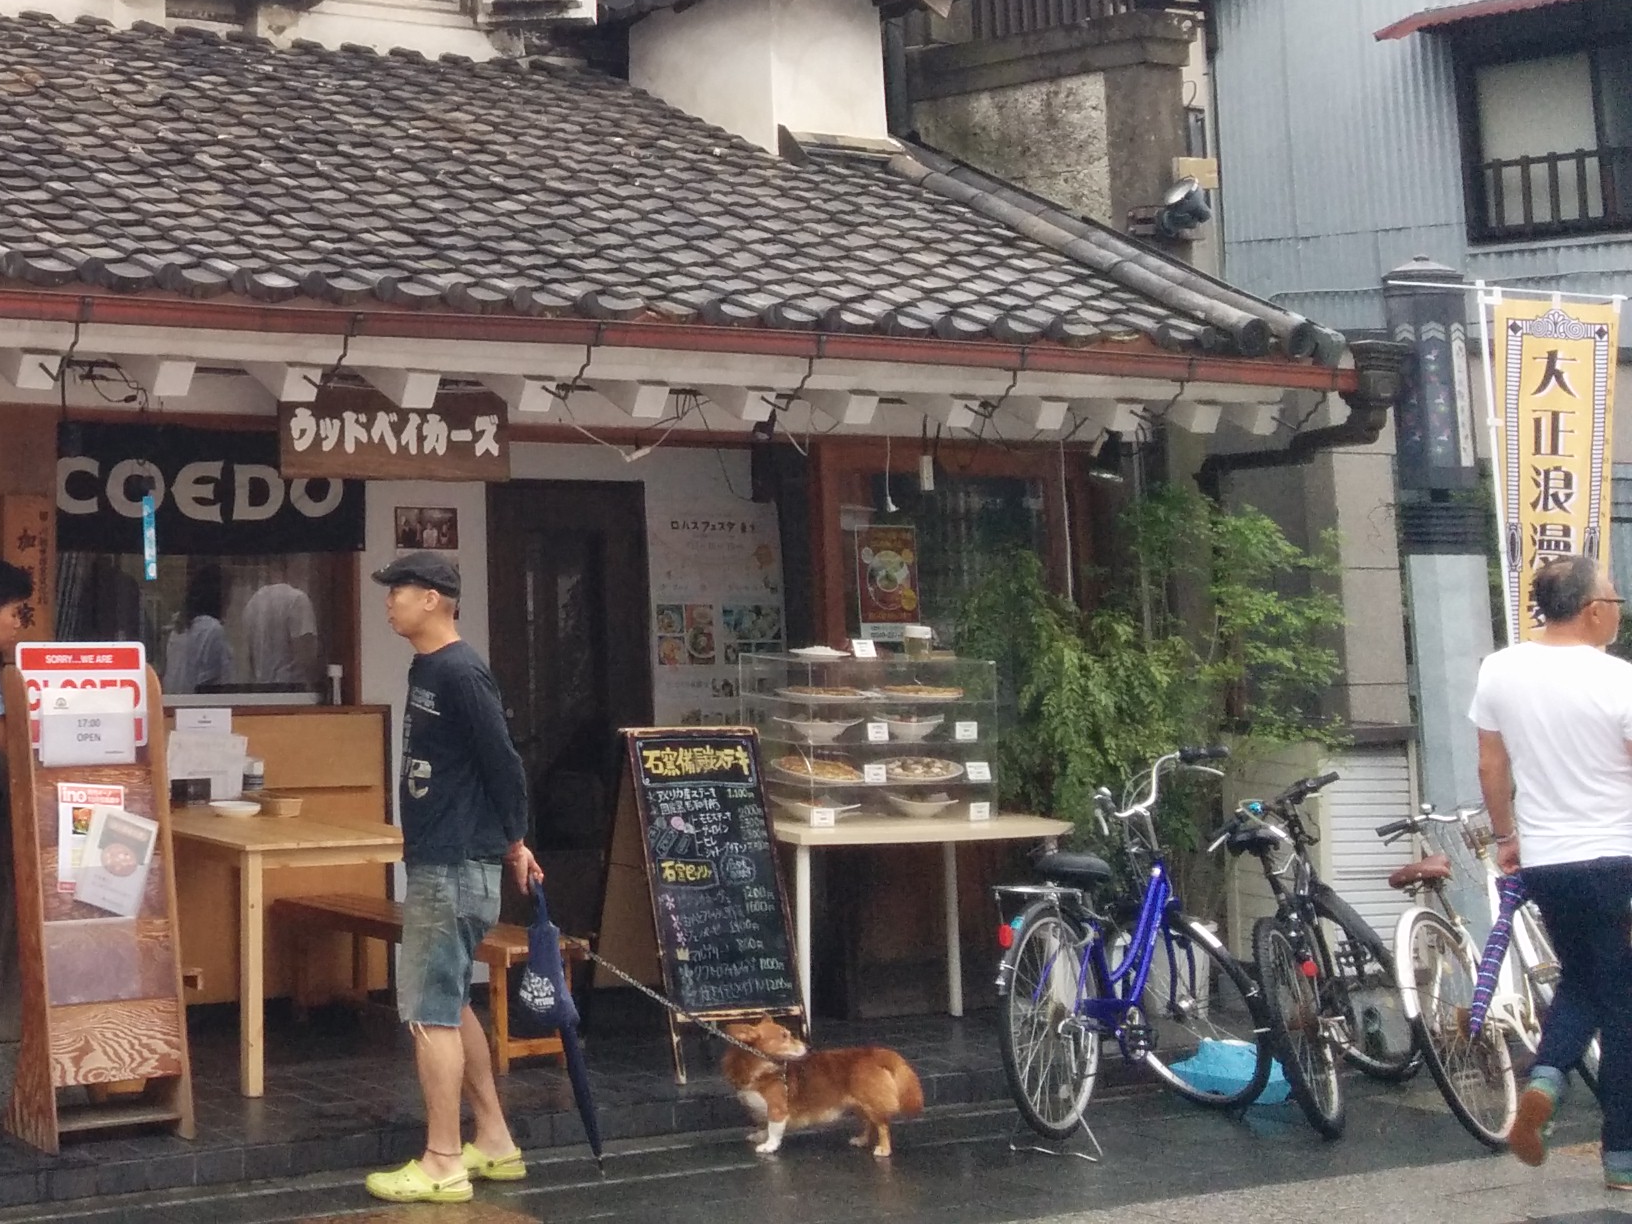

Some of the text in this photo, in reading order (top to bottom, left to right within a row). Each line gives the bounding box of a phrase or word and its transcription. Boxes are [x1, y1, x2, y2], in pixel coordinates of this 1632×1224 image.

[290, 407, 499, 458] ウッドベイカーズ
[56, 456, 344, 523] COEDO
[1529, 349, 1578, 628] 大正浪漫
[76, 733, 101, 742] OPEN
[77, 718, 101, 728] 17:00
